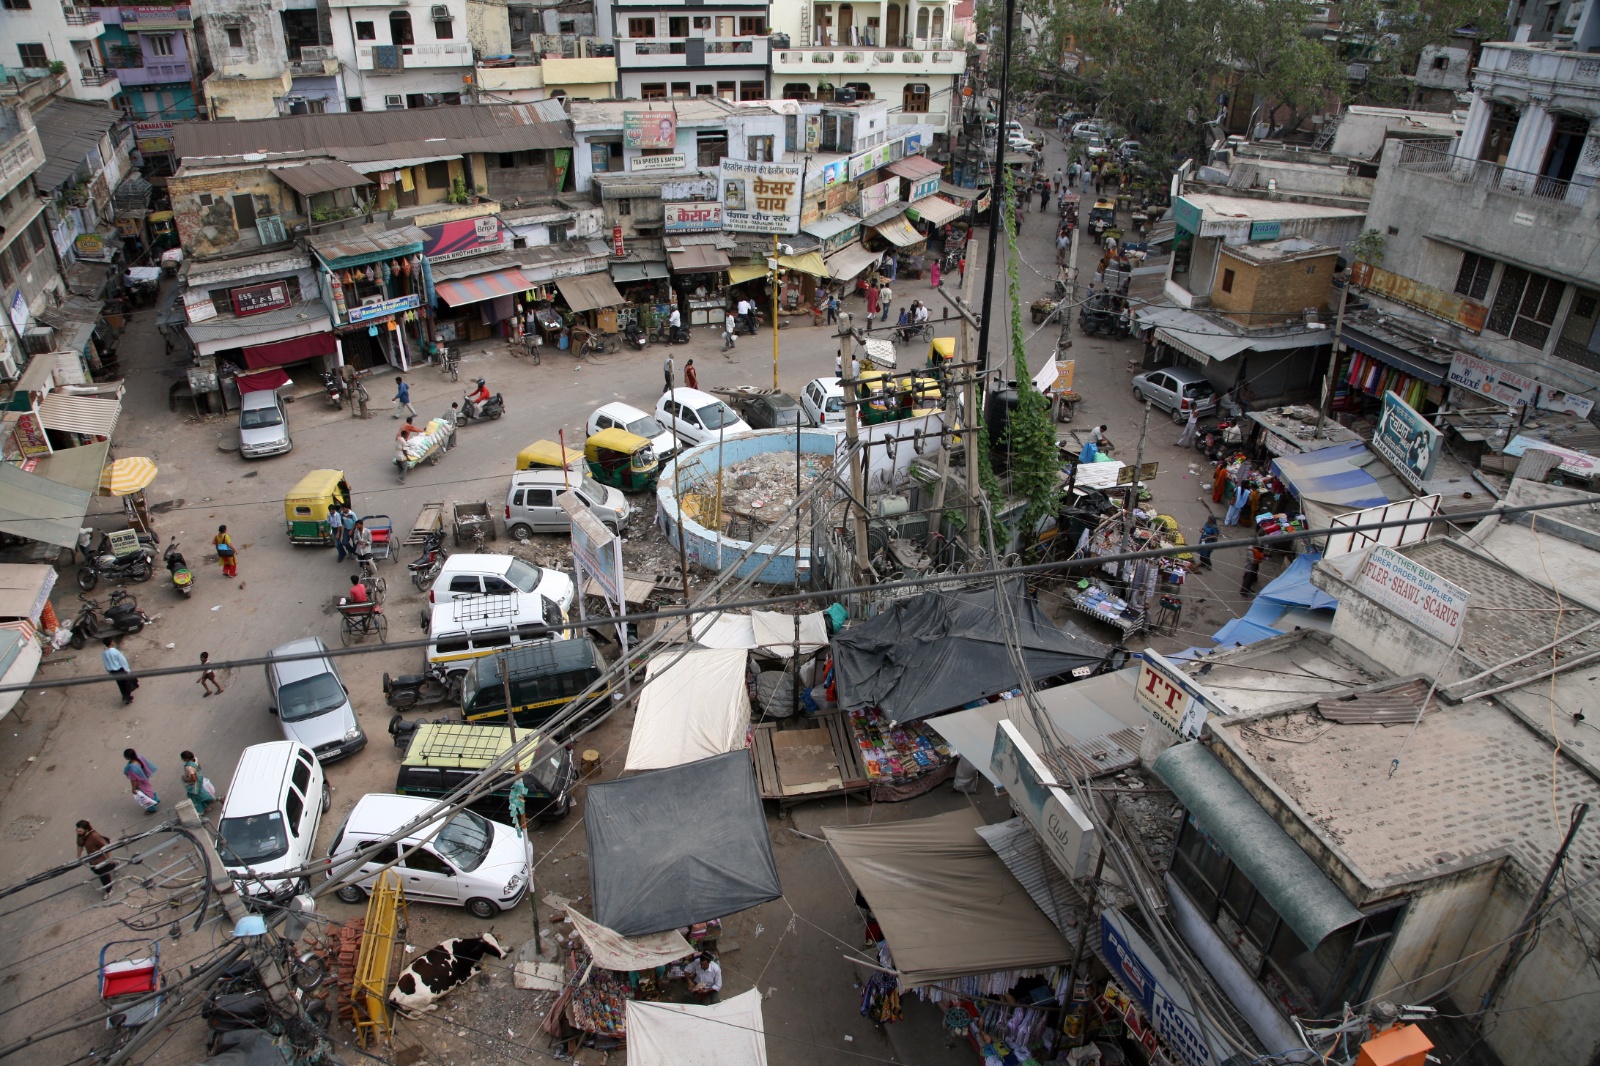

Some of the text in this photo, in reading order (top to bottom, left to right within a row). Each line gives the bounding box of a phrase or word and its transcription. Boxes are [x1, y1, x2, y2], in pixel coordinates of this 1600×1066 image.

[759, 164, 766, 174] की
[754, 176, 795, 196] केसर
[677, 208, 712, 222] केसर
[727, 210, 749, 219] पंजाब
[752, 212, 770, 220] चीप
[772, 214, 791, 222] स्टोर
[756, 198, 787, 211] चाय
[477, 224, 495, 233] Berger
[429, 249, 481, 262] RISHNA BROTHERS
[1450, 373, 1480, 390] DELUXE
[1455, 355, 1498, 374] RADHEY
[1500, 372, 1533, 391] SHAM
[1374, 438, 1395, 460] PRAKASH
[1381, 548, 1435, 583] TRY THEN BUY
[1362, 561, 1389, 586] UFLER
[1391, 576, 1420, 605] SHAWL
[1423, 595, 1459, 627] SCARVE
[1392, 563, 1417, 583] ORDER
[1418, 580, 1453, 604] SUPPLIER
[1359, 585, 1445, 638] ALSO CEREMIC PRODUCT
[1366, 580, 1398, 602] PRINTED
[1400, 599, 1435, 623] CROCHET
[1153, 711, 1190, 742] SUNNY
[1048, 814, 1068, 845] Club
[1108, 932, 1145, 987] PEPSI
[1156, 1004, 1204, 1066] Insenc
[1160, 1022, 1192, 1066] Hou
[1163, 998, 1209, 1060] Rama
